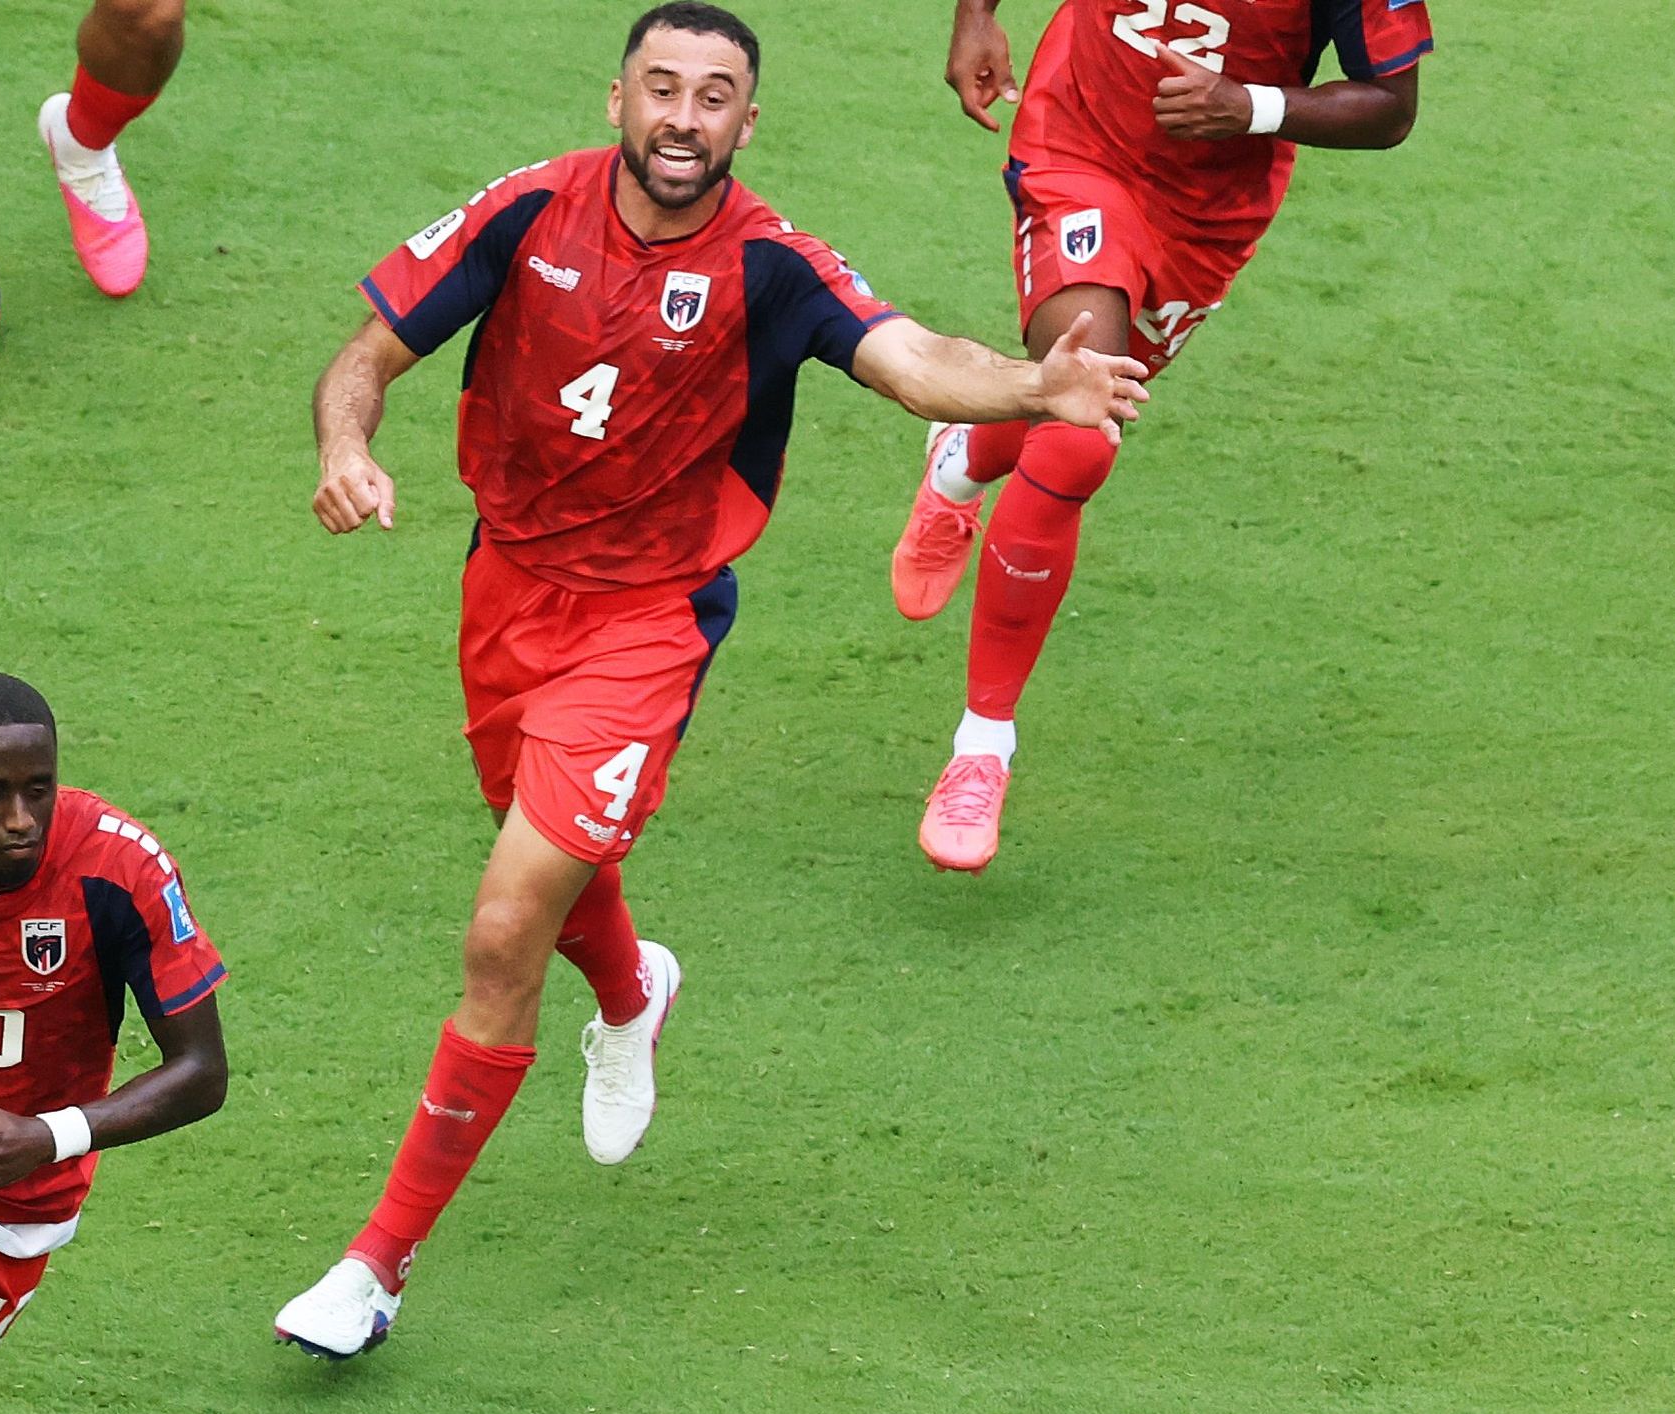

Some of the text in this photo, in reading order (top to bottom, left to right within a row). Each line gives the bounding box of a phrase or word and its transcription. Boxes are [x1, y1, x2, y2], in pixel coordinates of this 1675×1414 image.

[1112, 0, 1230, 74] 22
[559, 362, 620, 441] 4
[592, 741, 650, 821] 4
[25, 922, 62, 932] FCF
